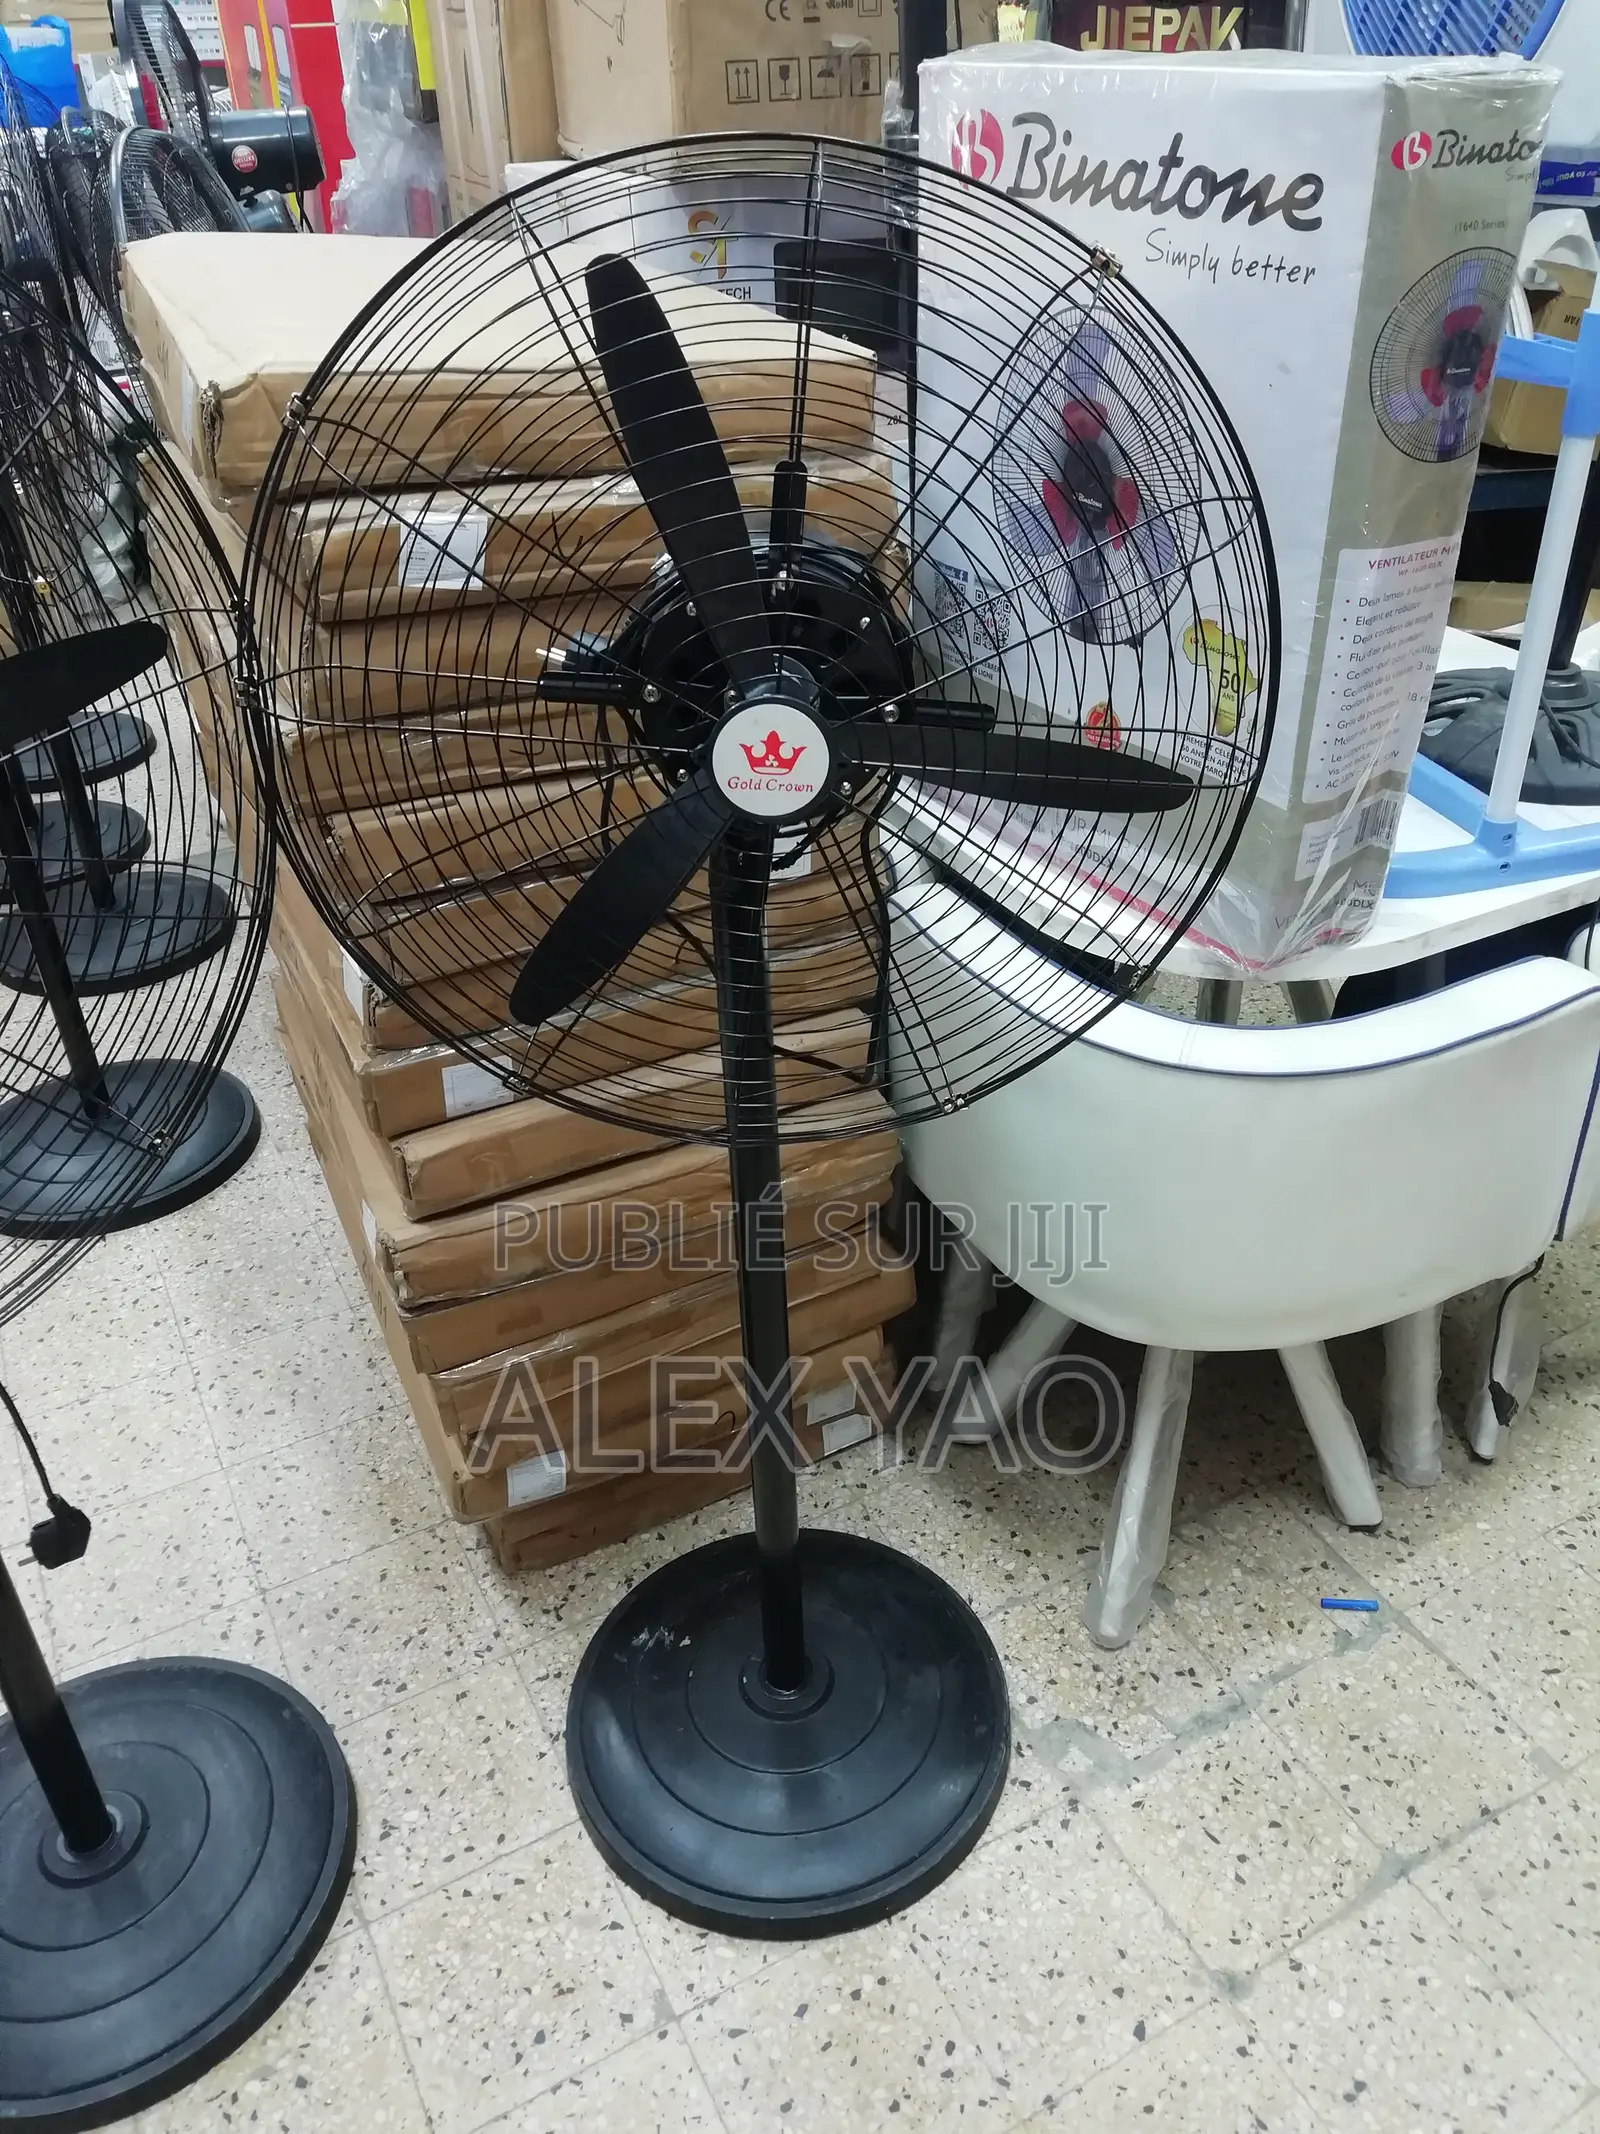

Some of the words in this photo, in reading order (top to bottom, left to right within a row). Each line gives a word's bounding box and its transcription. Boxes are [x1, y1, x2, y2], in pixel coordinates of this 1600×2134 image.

[1080, 5, 1244, 50] JIEPAK
[1006, 112, 1324, 232] Binatone
[1144, 227, 1218, 280] Simply
[1231, 245, 1317, 284] better
[1368, 547, 1439, 570] VENTILATEUR
[1417, 661, 1424, 671] 3
[1220, 669, 1241, 694] 50
[1222, 692, 1236, 702] ANS
[1331, 754, 1342, 763] Le
[1328, 768, 1340, 776] vis
[727, 776, 761, 791] Gold
[765, 779, 813, 792] Crown
[1325, 778, 1340, 790] AC
